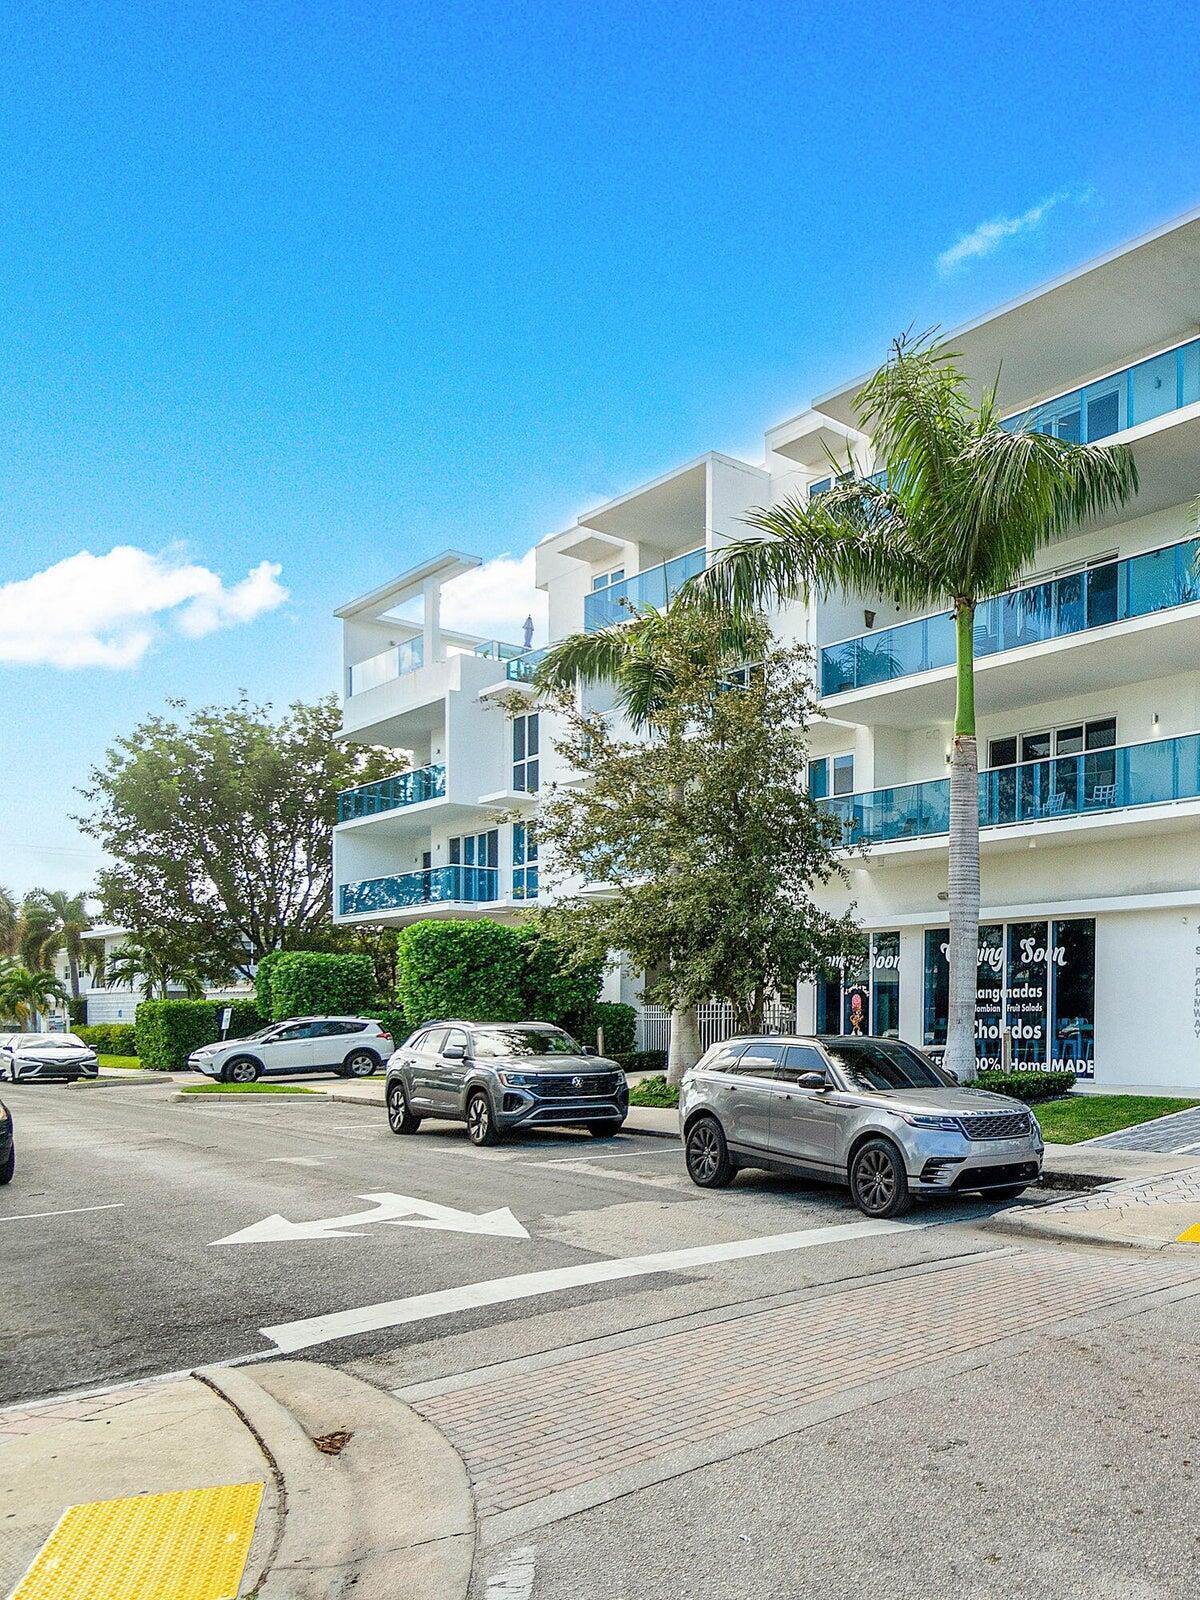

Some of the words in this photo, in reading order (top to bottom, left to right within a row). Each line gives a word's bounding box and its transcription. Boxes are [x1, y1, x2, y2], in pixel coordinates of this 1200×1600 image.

[975, 983, 1043, 1003] angnadas
[975, 1003, 1000, 1013] lombian
[1007, 1003, 1020, 1012] Fruit
[1021, 1002, 1043, 1012] Salads
